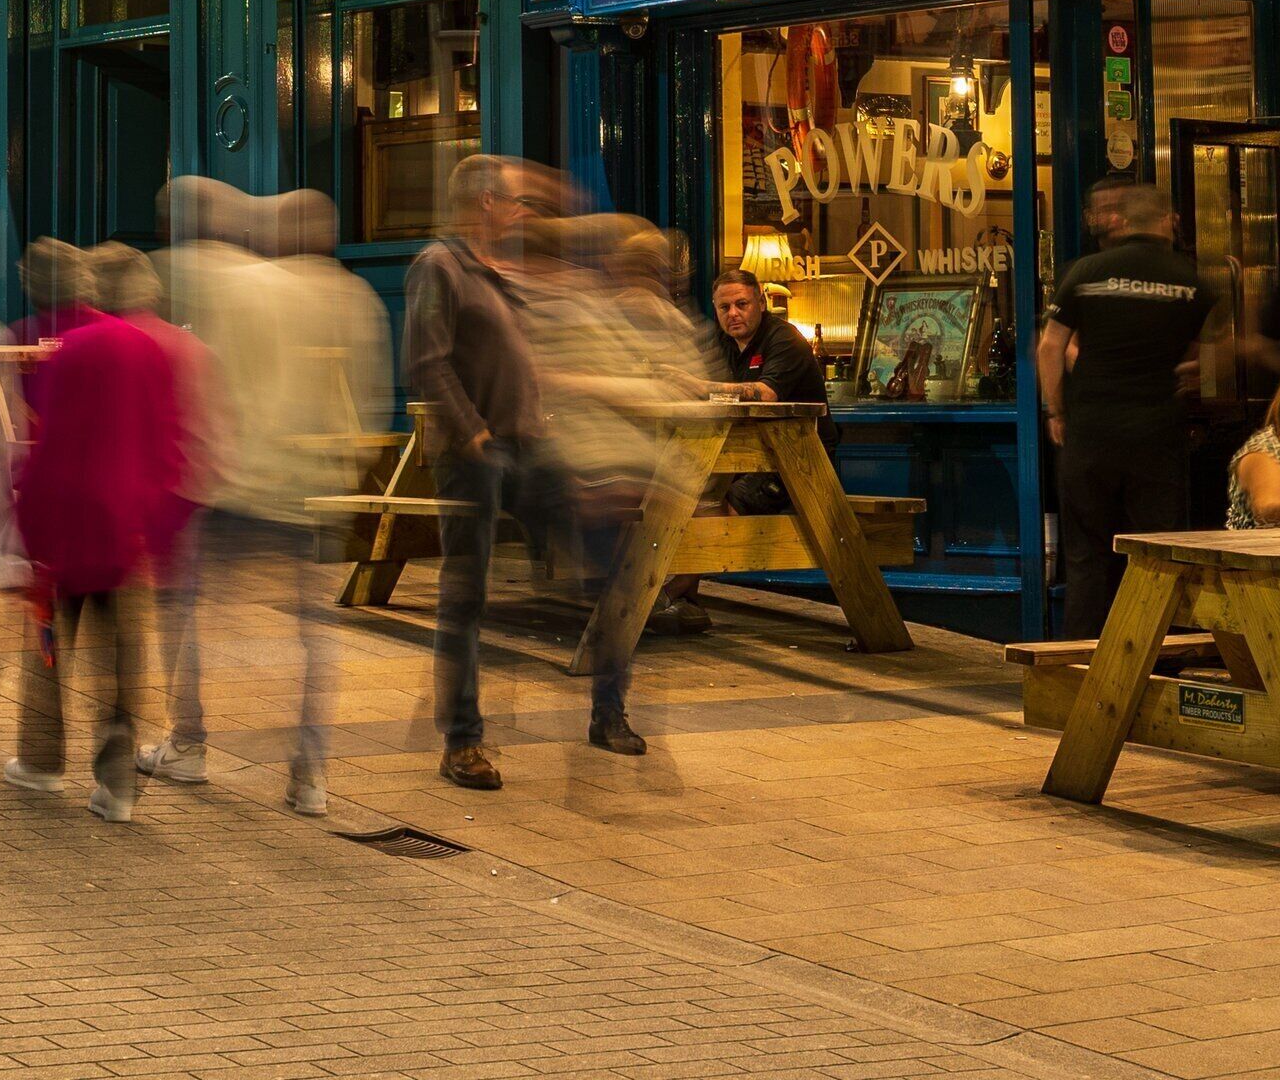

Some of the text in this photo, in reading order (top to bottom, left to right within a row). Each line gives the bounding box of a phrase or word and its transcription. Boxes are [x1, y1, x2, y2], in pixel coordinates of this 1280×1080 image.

[765, 117, 990, 226] POWERS
[870, 240, 889, 268] P
[764, 255, 821, 282] IRISH
[1182, 705, 1201, 716] TIMBER
[1202, 709, 1231, 722] PRODUCTS
[1184, 690, 1237, 714] M. Doherty
